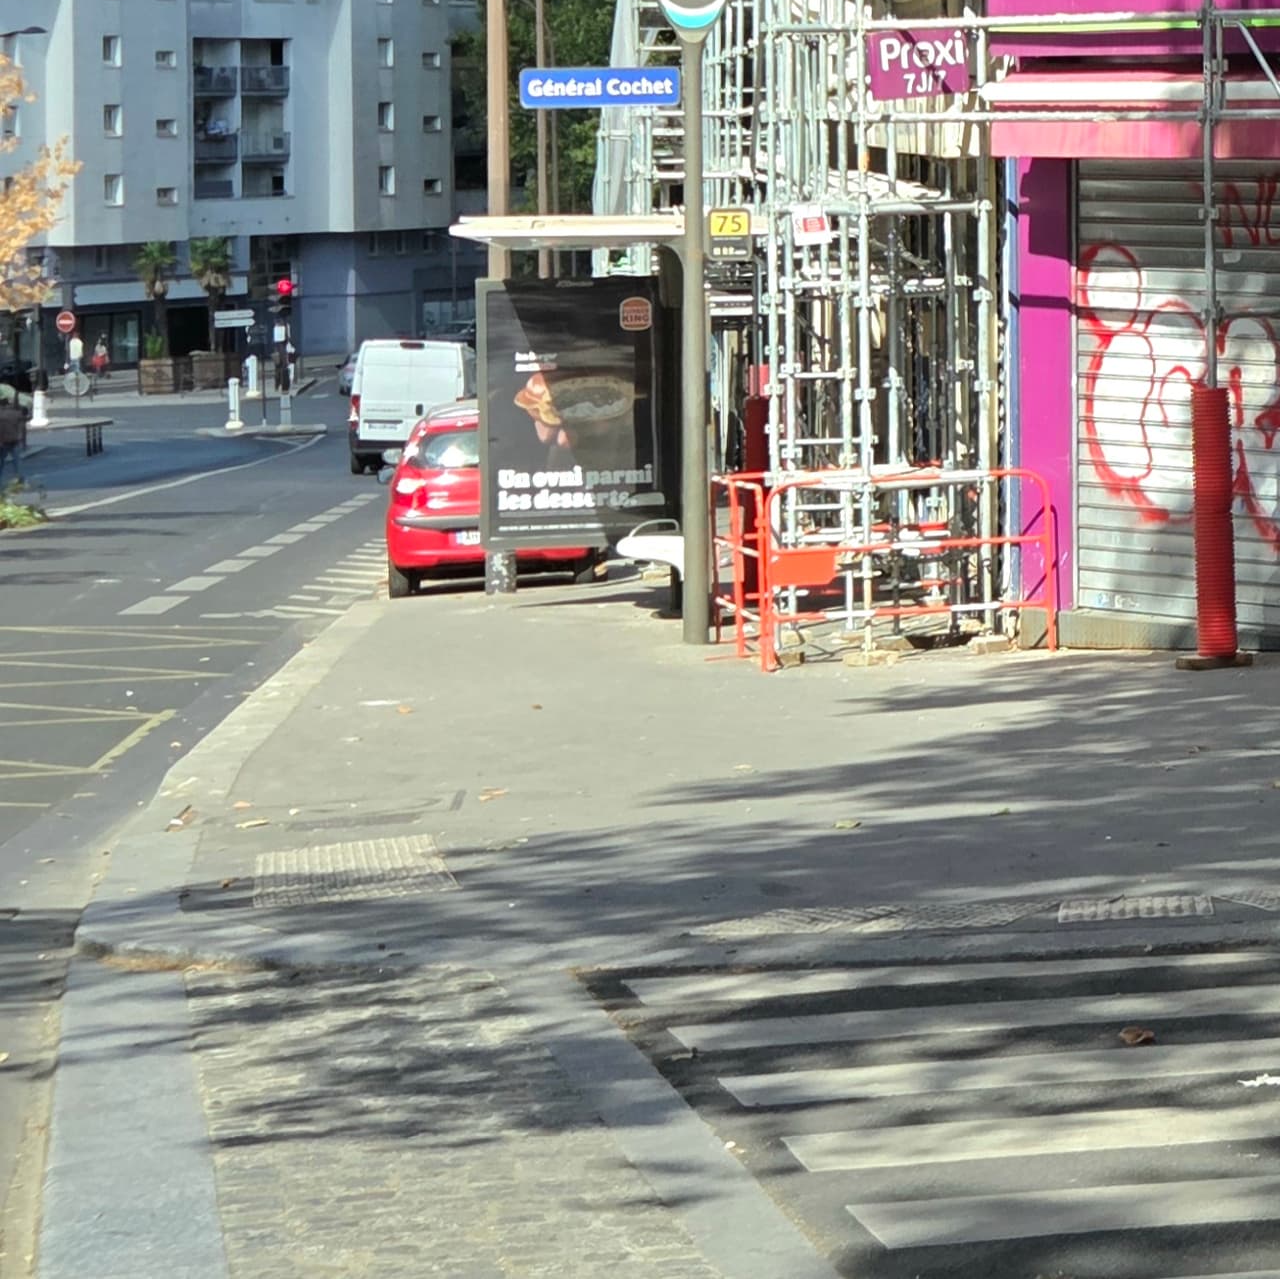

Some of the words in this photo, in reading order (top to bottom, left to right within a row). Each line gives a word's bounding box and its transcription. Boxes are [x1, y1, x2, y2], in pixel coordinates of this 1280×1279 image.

[880, 30, 965, 72] Proxi
[527, 78, 602, 97] Général
[606, 77, 673, 96] Cochet
[716, 215, 742, 233] 75
[498, 469, 530, 489] Un
[532, 465, 583, 488] ovni
[585, 464, 652, 490] parmi
[498, 490, 531, 511] les
